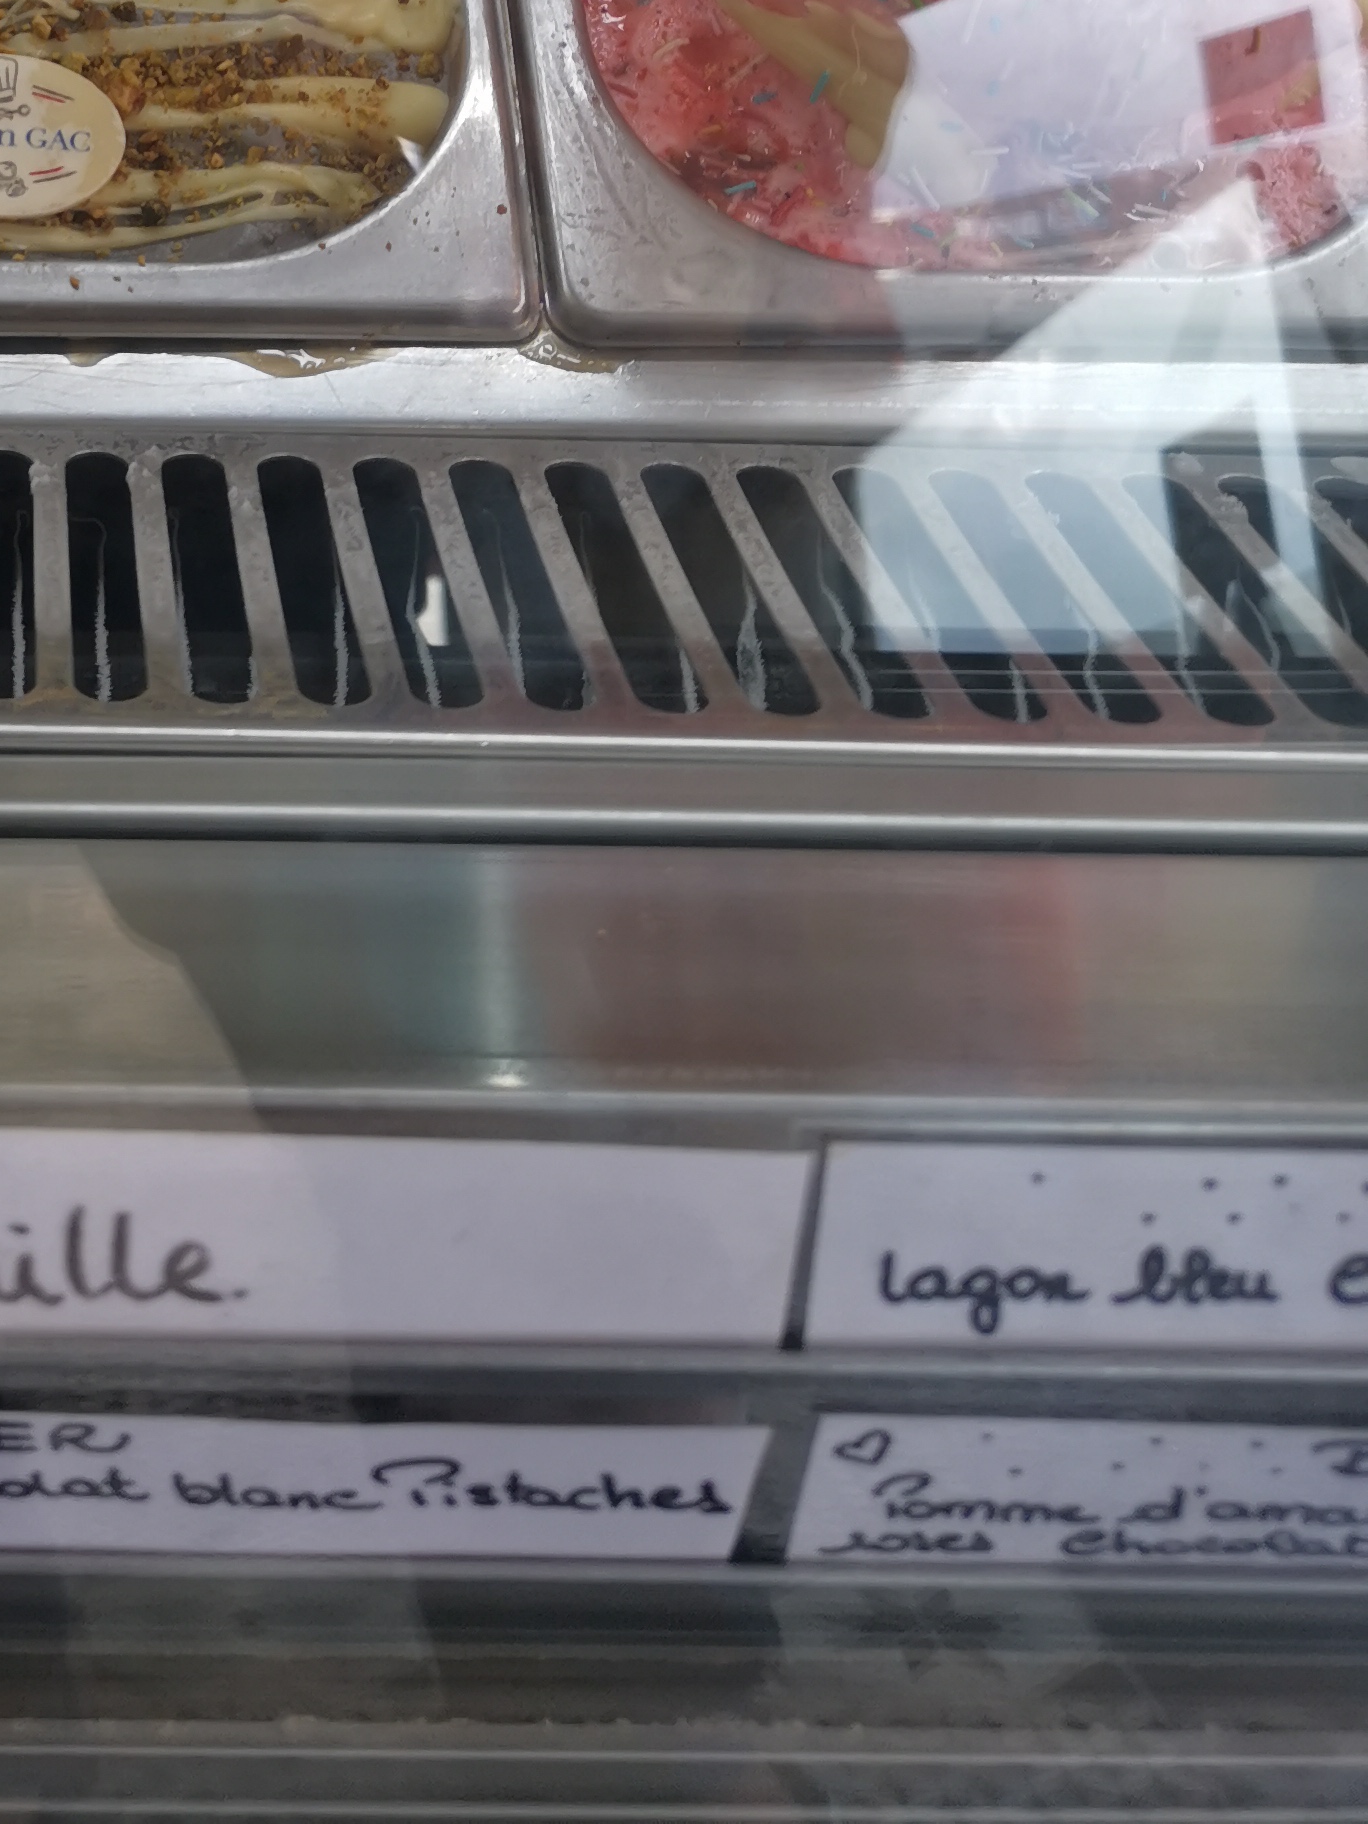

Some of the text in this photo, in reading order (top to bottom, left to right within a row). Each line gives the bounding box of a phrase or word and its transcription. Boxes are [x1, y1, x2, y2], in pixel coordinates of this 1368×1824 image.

[25, 127, 92, 154] GAC
[173, 1471, 384, 1512] blanc
[370, 1456, 733, 1514] Pistaches
